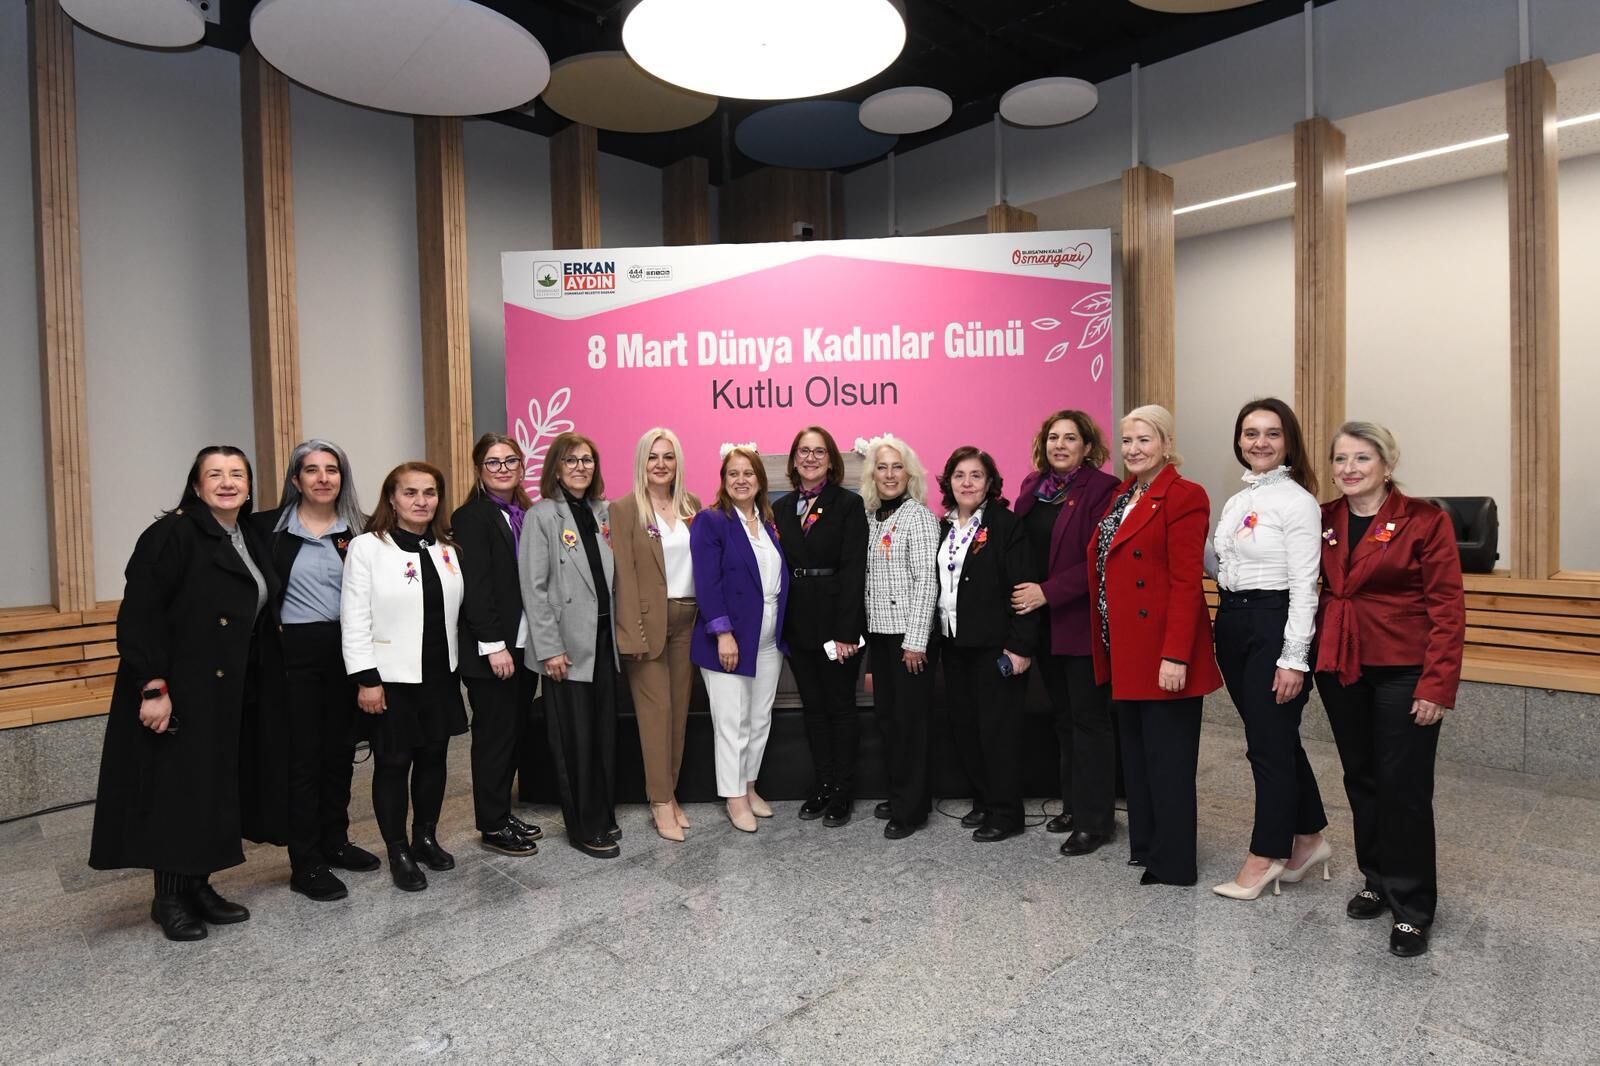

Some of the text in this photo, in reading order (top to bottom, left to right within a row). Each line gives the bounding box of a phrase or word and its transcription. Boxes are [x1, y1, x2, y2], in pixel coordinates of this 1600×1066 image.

[1012, 249, 1084, 267] Osmangazi
[563, 261, 615, 275] ERKAN
[566, 275, 613, 290] AYDIN
[587, 320, 1025, 372] 8 Mart Dünya Kadınlar Günü
[712, 376, 898, 410] Kutlu Olsun
